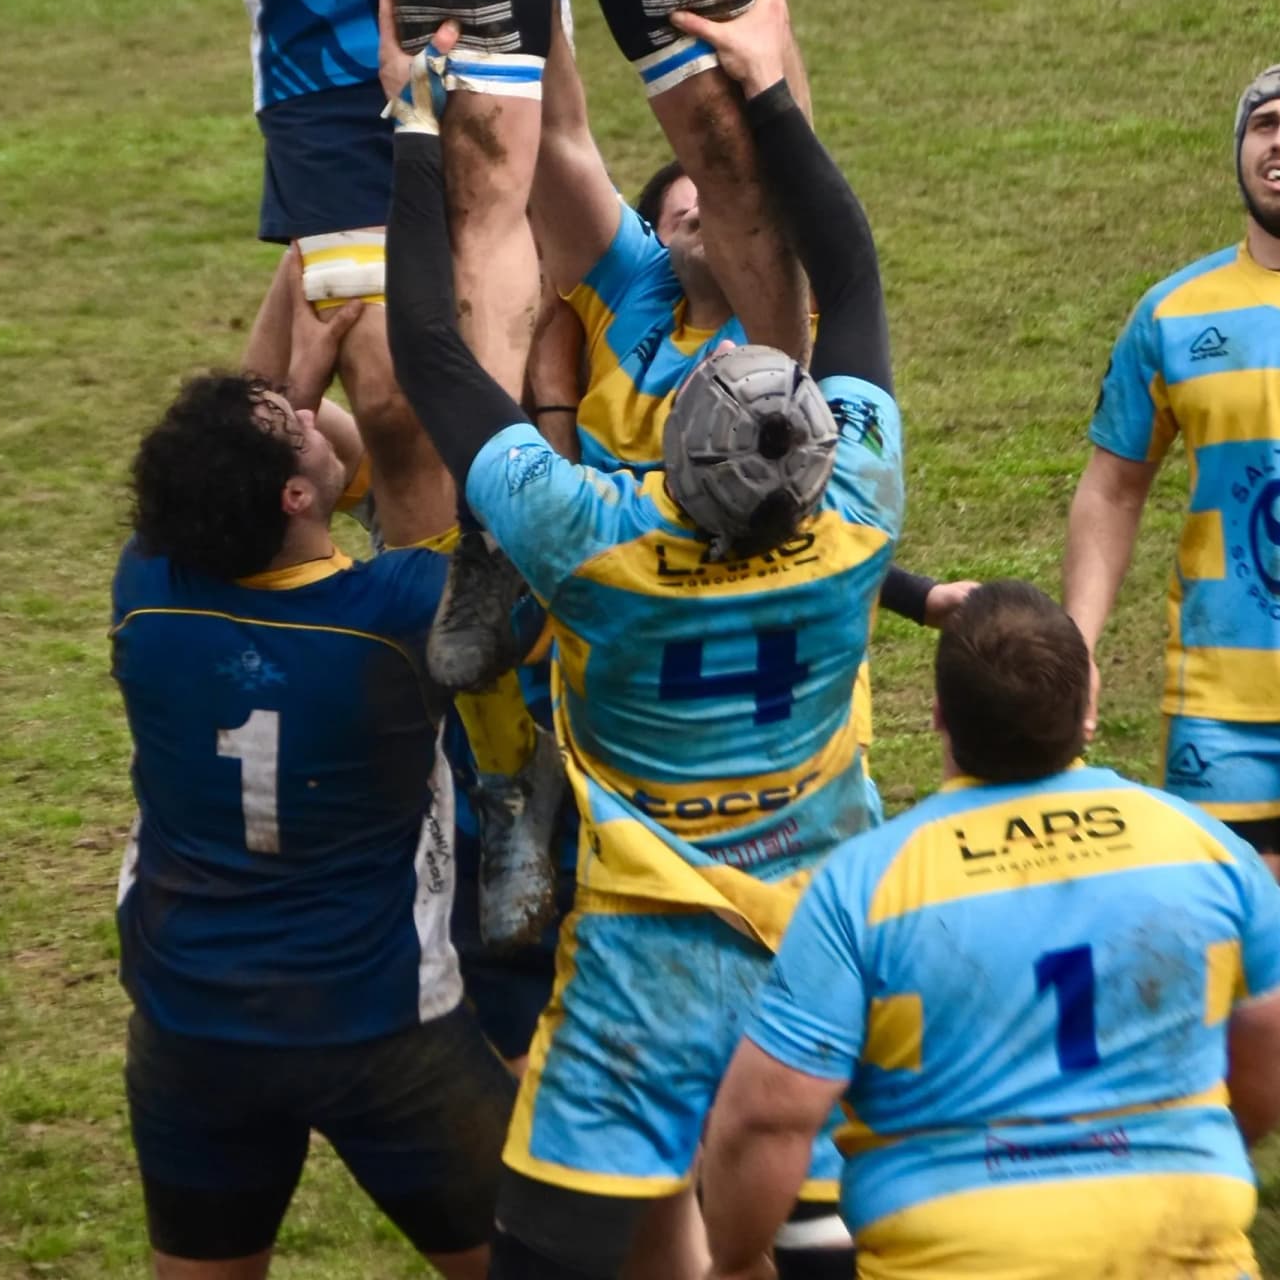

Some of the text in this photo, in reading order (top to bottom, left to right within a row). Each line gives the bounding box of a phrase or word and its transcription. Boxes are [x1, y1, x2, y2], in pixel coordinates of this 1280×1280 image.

[1229, 543, 1252, 581] SC
[657, 628, 813, 726] 4
[216, 708, 282, 855] 1
[954, 805, 1127, 862] LARS
[1033, 941, 1101, 1075] 1
